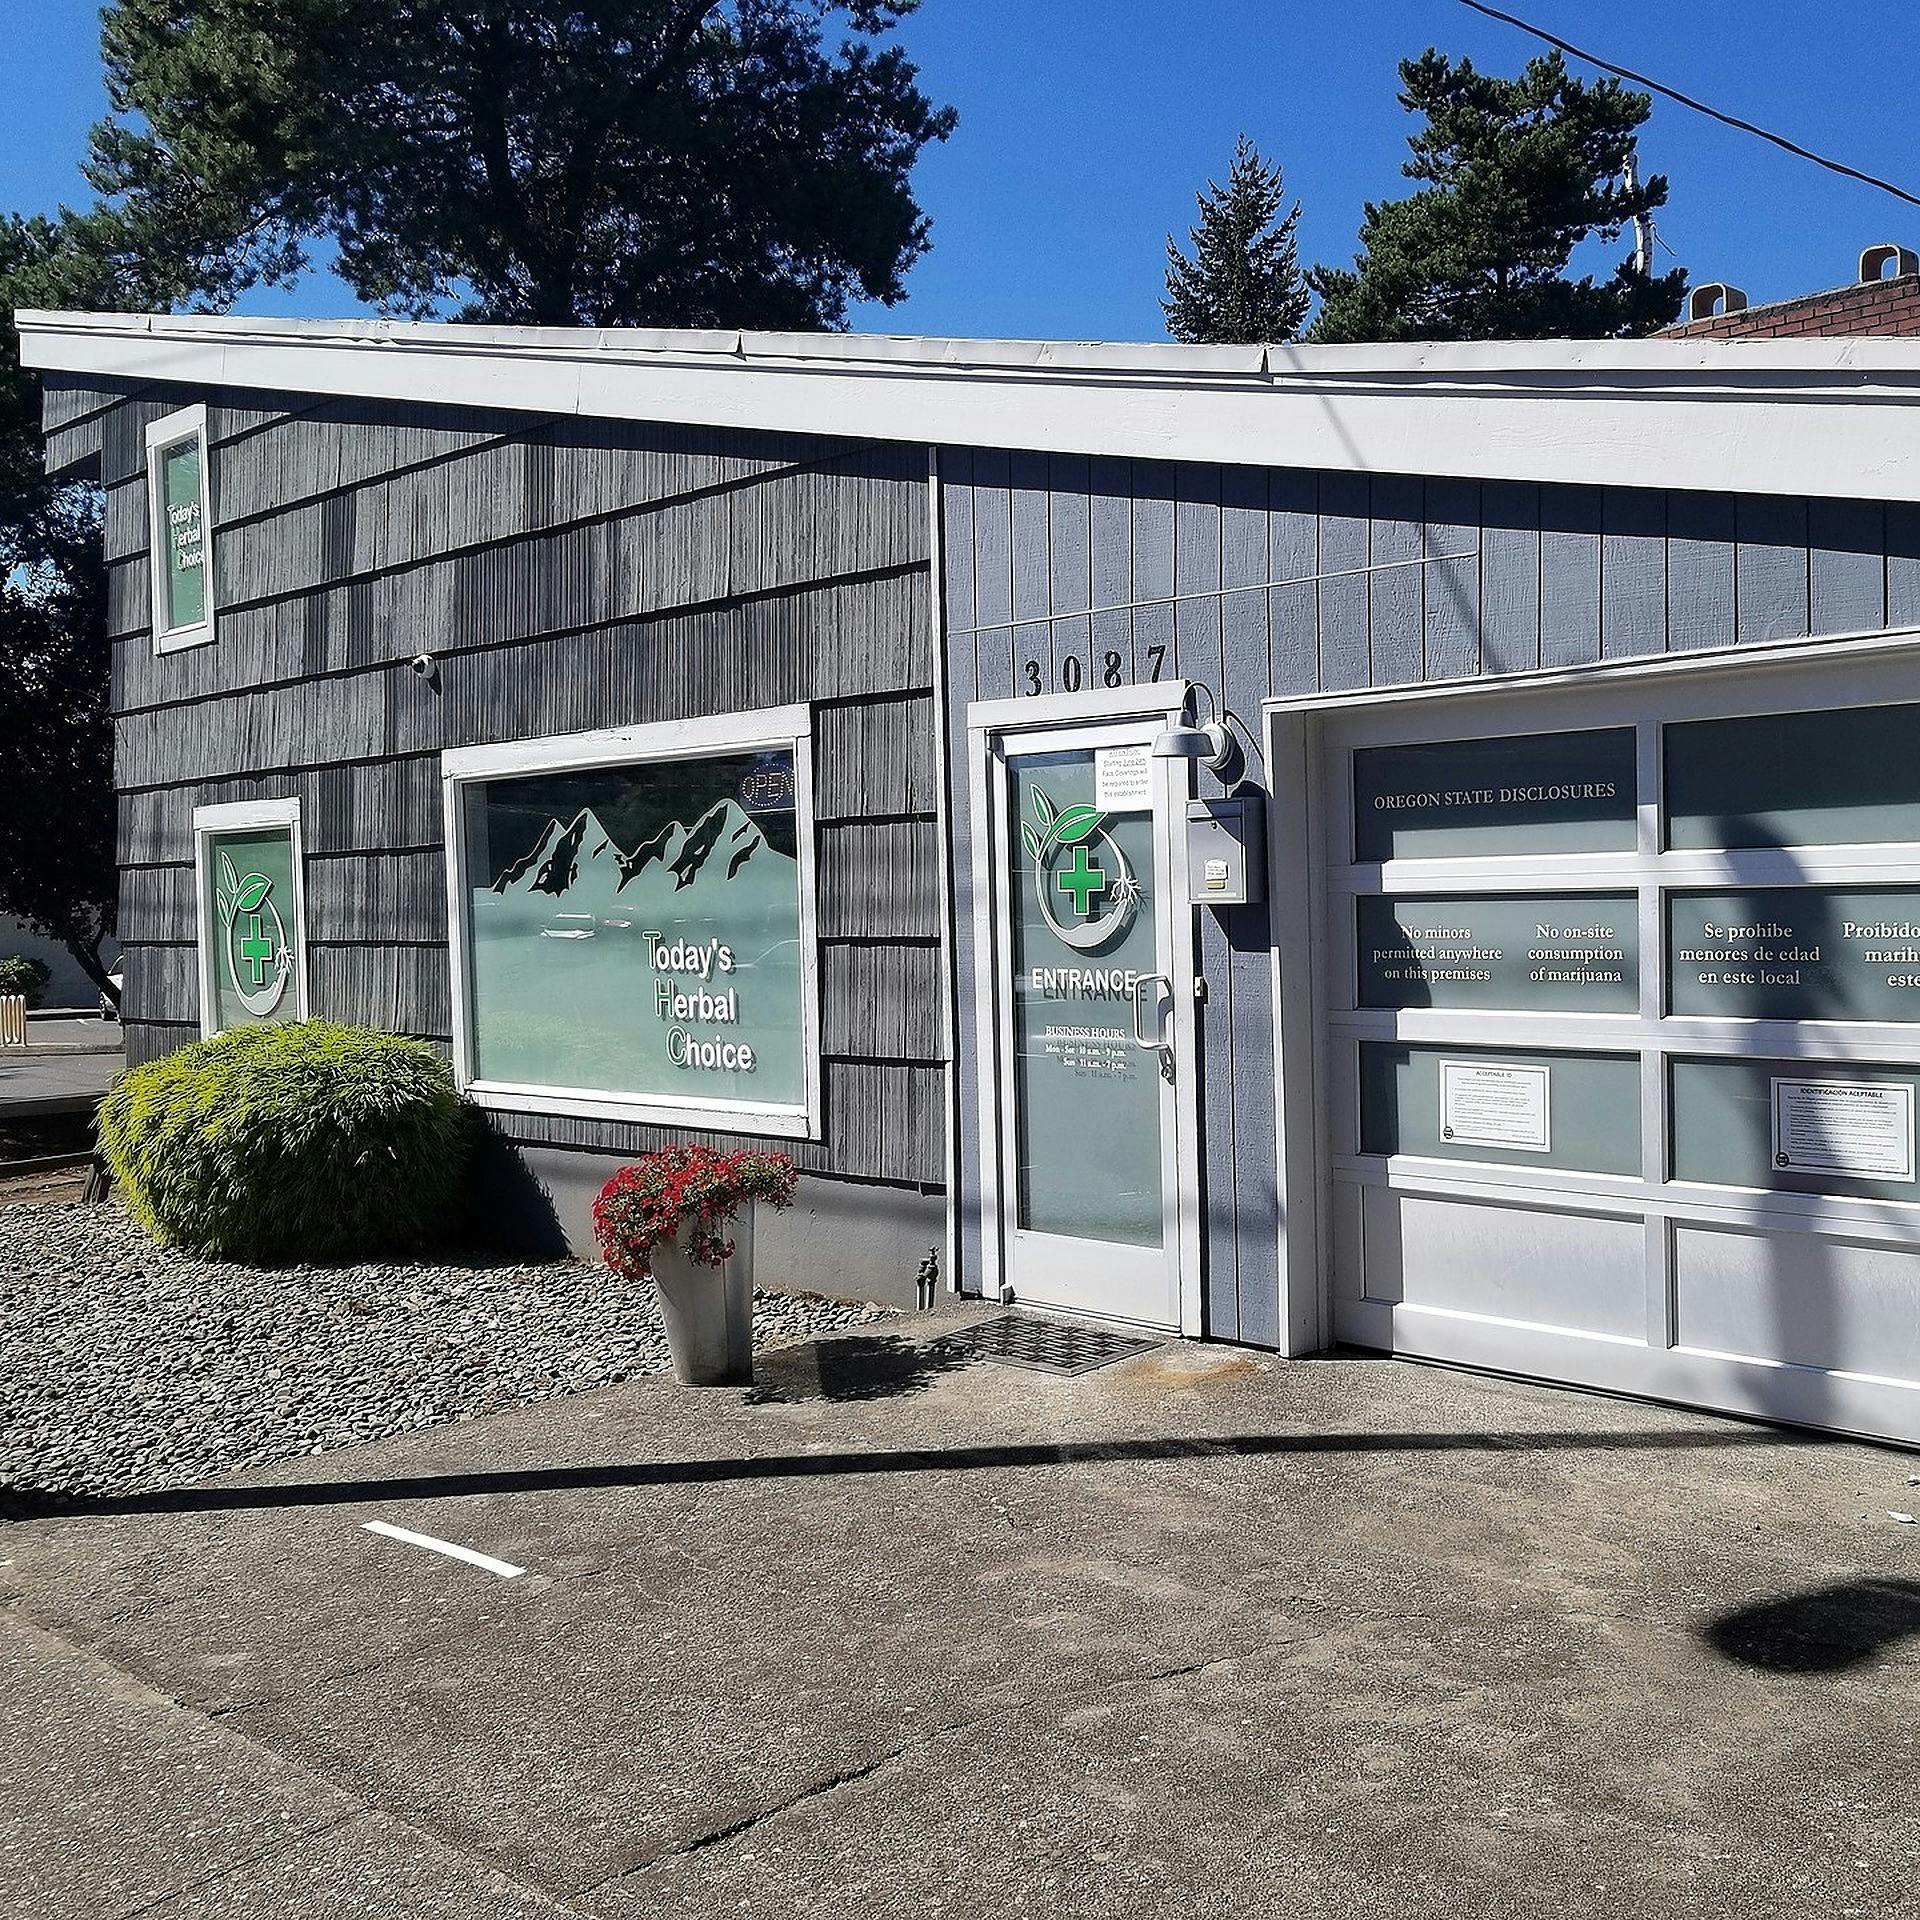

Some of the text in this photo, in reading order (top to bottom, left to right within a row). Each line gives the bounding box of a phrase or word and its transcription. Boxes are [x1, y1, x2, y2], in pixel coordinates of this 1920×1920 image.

[167, 501, 200, 525] Today's
[171, 523, 201, 547] Herbal
[1025, 645, 1166, 697] 3087
[742, 771, 794, 799] OPEN
[1374, 782, 1616, 811] OREGON STATE DISCLOSURES
[1401, 925, 1471, 940] No minors
[1535, 923, 1614, 939] No on-site
[1704, 923, 1793, 943] Se prohibe
[1842, 922, 1920, 938] Proibido
[642, 930, 733, 979] Today's
[1373, 947, 1503, 964] permitted anywhere
[1528, 948, 1624, 964] consumption
[1679, 946, 1821, 962] menores de edad
[1865, 946, 1920, 962] marih
[1032, 968, 1137, 992] ENTRANCE
[1384, 966, 1490, 984] on this premises
[1529, 966, 1622, 985] of marijuana
[1698, 970, 1801, 985] en este local
[654, 978, 735, 1021] Herbal
[1045, 1026, 1126, 1040] BUSINESS HOURS
[666, 1025, 753, 1070] Choice
[1063, 1057, 1075, 1067] Sun
